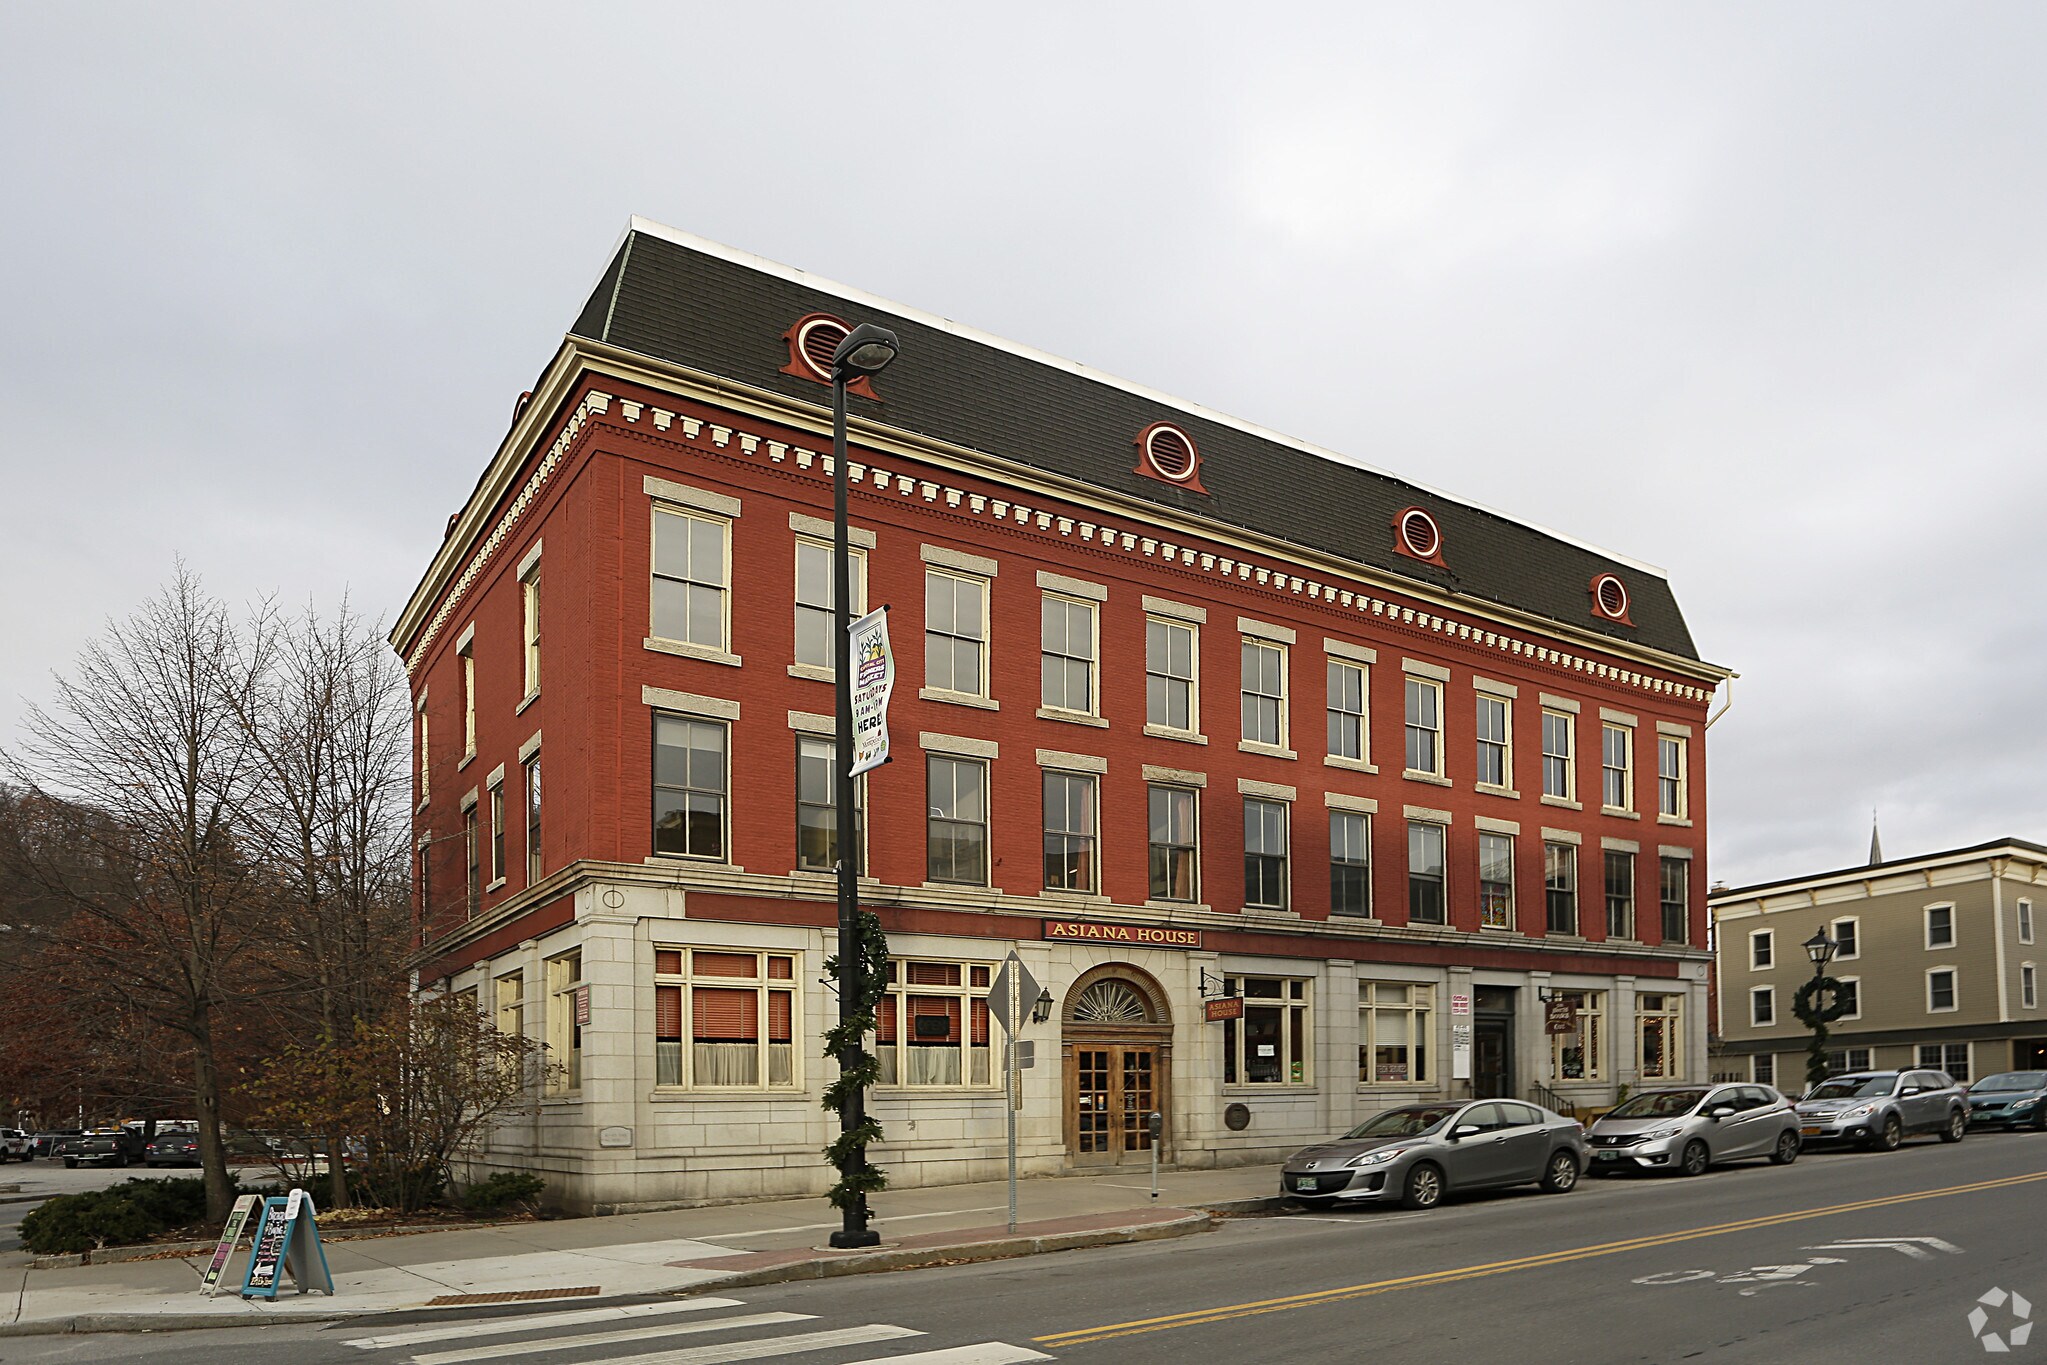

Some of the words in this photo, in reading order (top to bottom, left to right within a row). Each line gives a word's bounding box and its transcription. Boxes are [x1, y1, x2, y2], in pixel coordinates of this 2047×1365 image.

[1052, 923, 1130, 940] ASIANA
[1136, 928, 1197, 944] HOUSE
[1209, 1002, 1239, 1011] ASIANA
[1211, 1008, 1238, 1018] HOUSE
